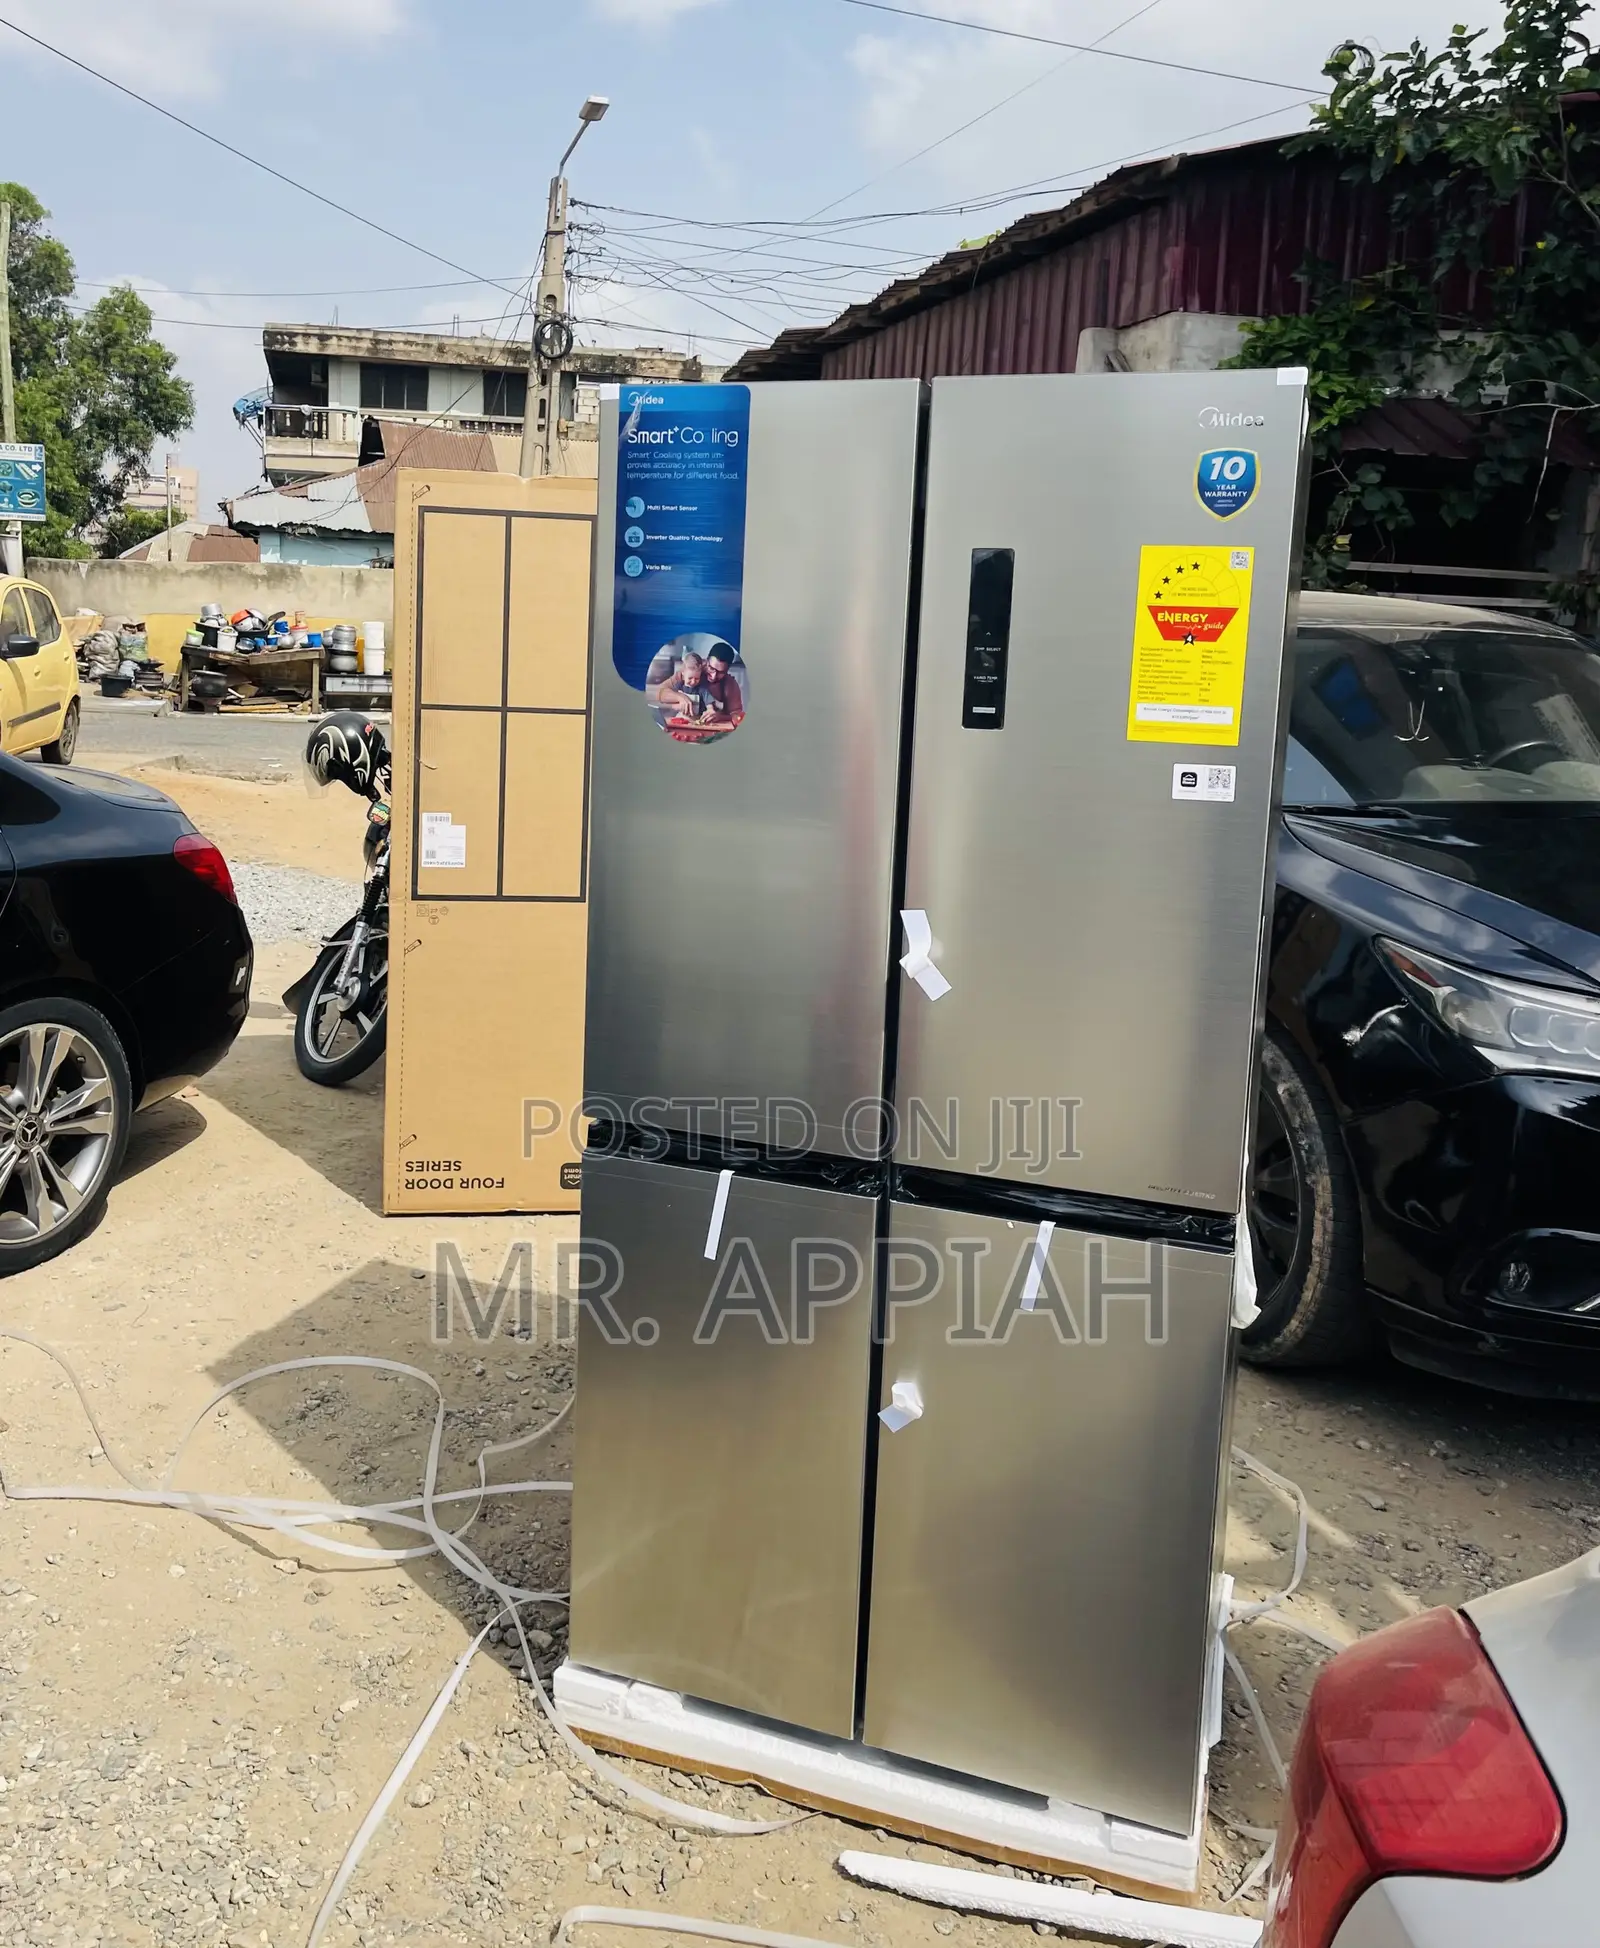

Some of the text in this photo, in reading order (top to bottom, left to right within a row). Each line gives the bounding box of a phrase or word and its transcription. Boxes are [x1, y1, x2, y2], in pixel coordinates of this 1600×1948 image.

[1199, 408, 1264, 427] Midea
[653, 451, 682, 460] Cooling
[683, 452, 710, 460] system
[652, 462, 686, 470] accuracy
[1210, 456, 1247, 481] 10
[626, 472, 672, 480] temperature
[691, 535, 724, 543] Technology
[1157, 610, 1208, 625] ENERGY
[1203, 621, 1225, 631] guide
[405, 1160, 462, 1172] SERIES
[405, 1177, 505, 1190] FOUR DOOR
